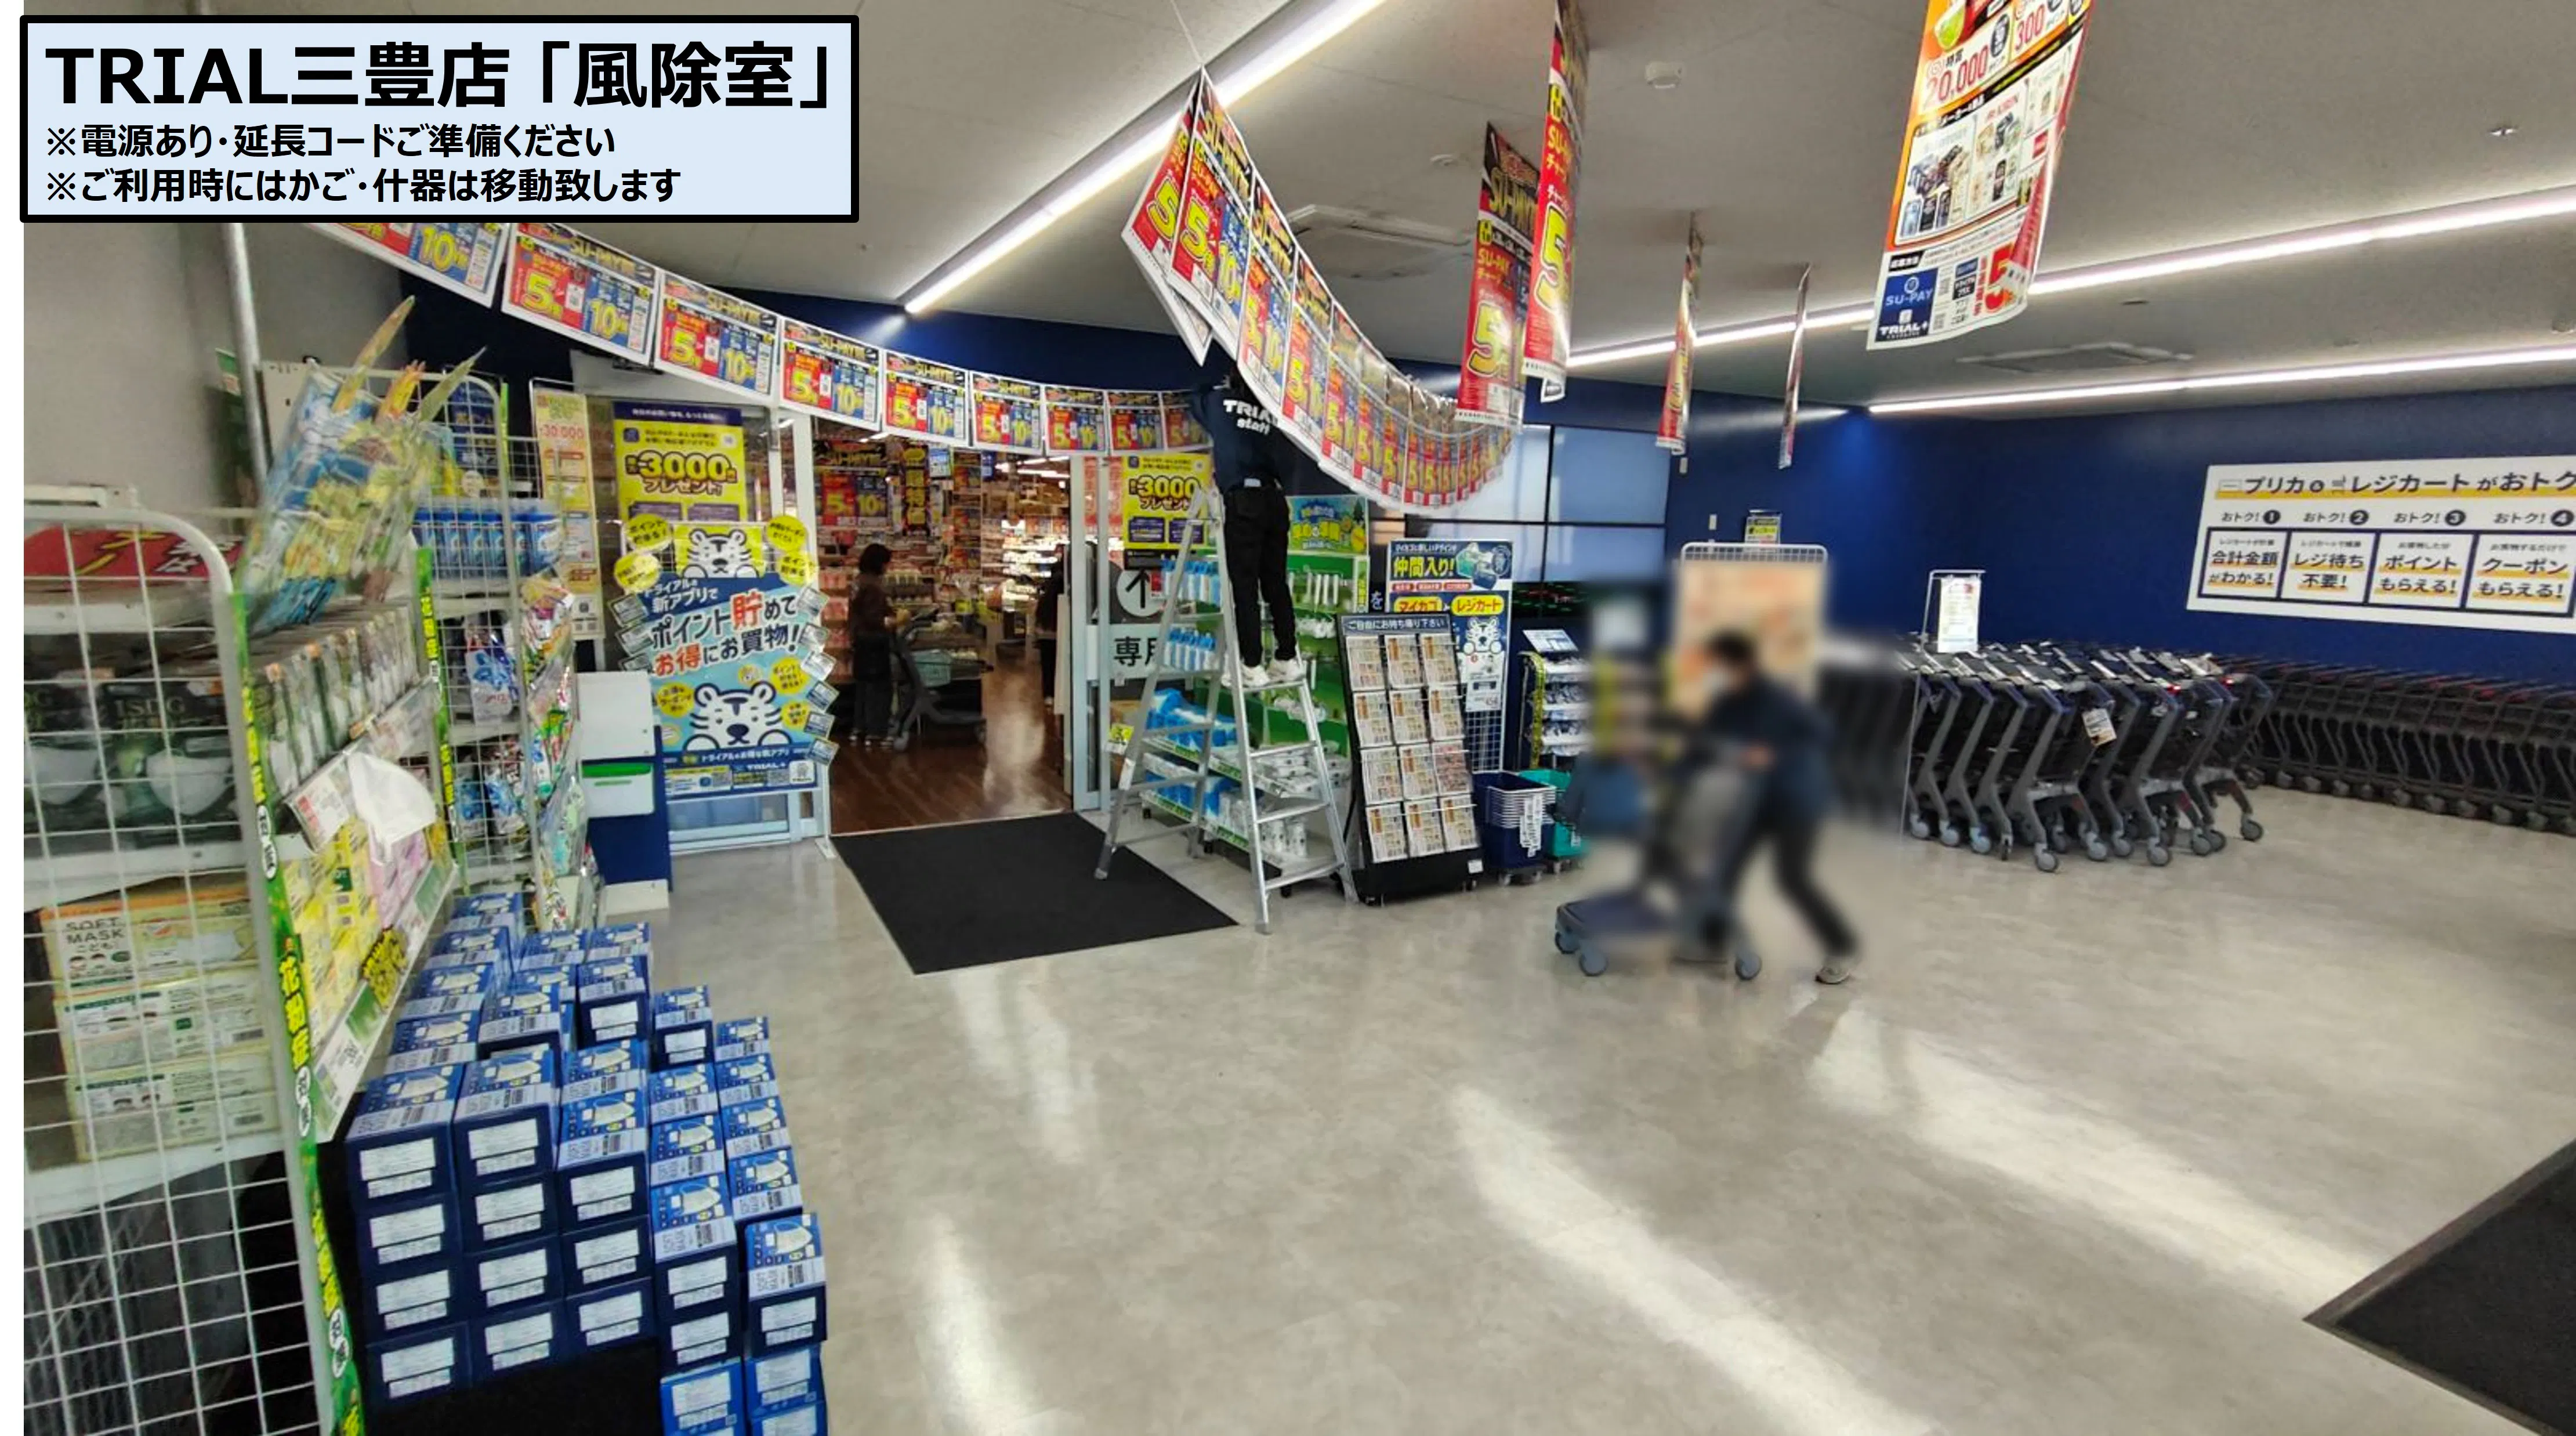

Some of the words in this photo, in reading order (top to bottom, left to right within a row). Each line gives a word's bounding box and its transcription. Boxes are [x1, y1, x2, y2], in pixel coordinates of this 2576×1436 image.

[1886, 288, 1933, 306] SU-PAY
[1393, 556, 1455, 577] 仲間入り!
[2212, 551, 2278, 565] 合計金額
[2294, 553, 2364, 569] レジ待ち
[2385, 554, 2457, 571] ポイント
[2483, 558, 2568, 575] クーポン
[2209, 571, 2274, 585] がわかる!
[2302, 573, 2347, 588] 不要!
[2381, 577, 2457, 594] もらえる!
[2479, 581, 2563, 598] もらえる!
[651, 591, 799, 650] ポイント貯めて
